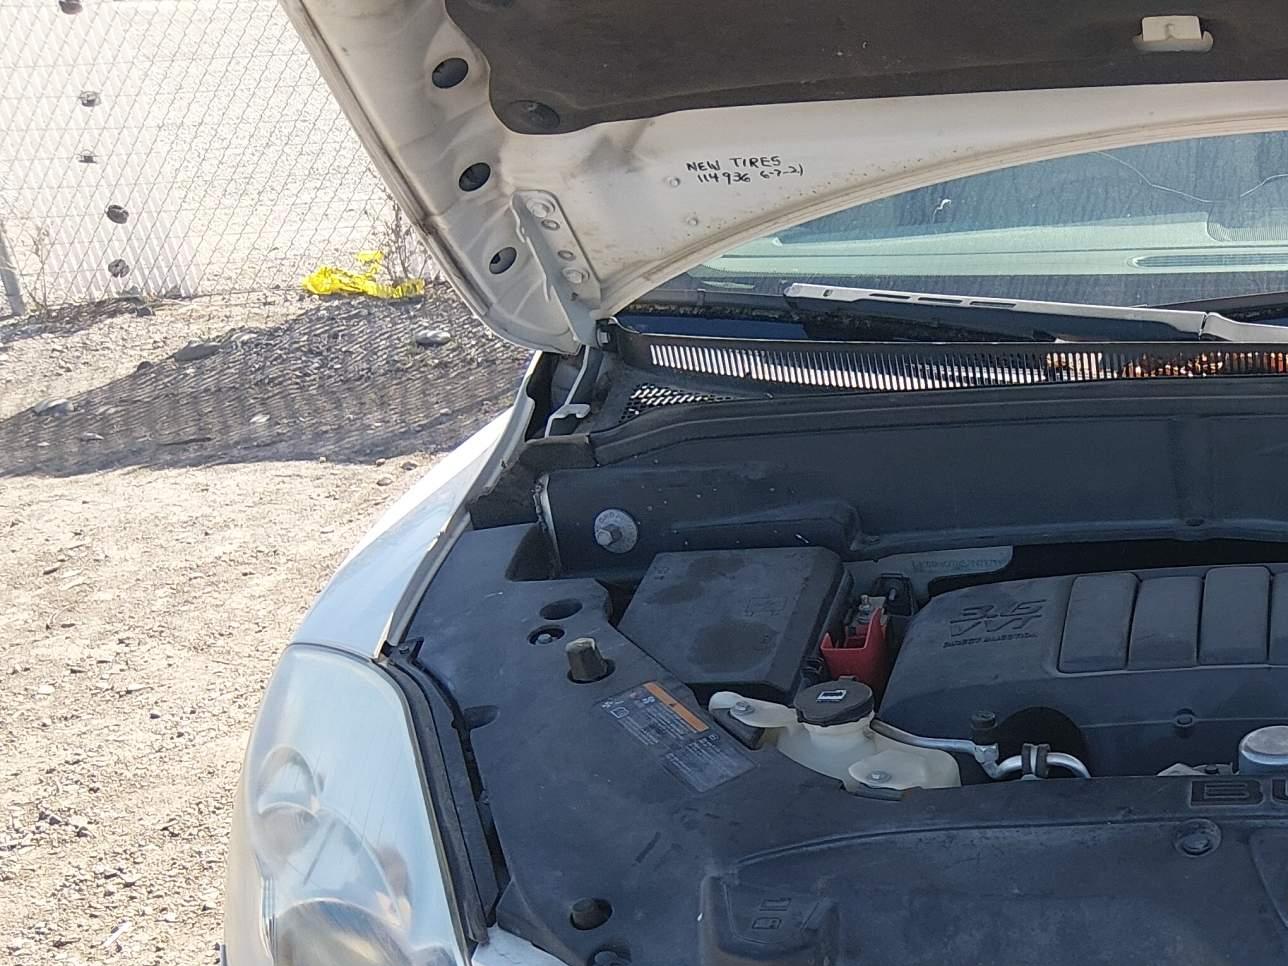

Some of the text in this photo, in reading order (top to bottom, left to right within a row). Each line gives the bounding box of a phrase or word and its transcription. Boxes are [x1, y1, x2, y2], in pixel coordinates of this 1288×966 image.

[686, 156, 781, 171] NEW TIRES
[949, 614, 1042, 638] VVT
